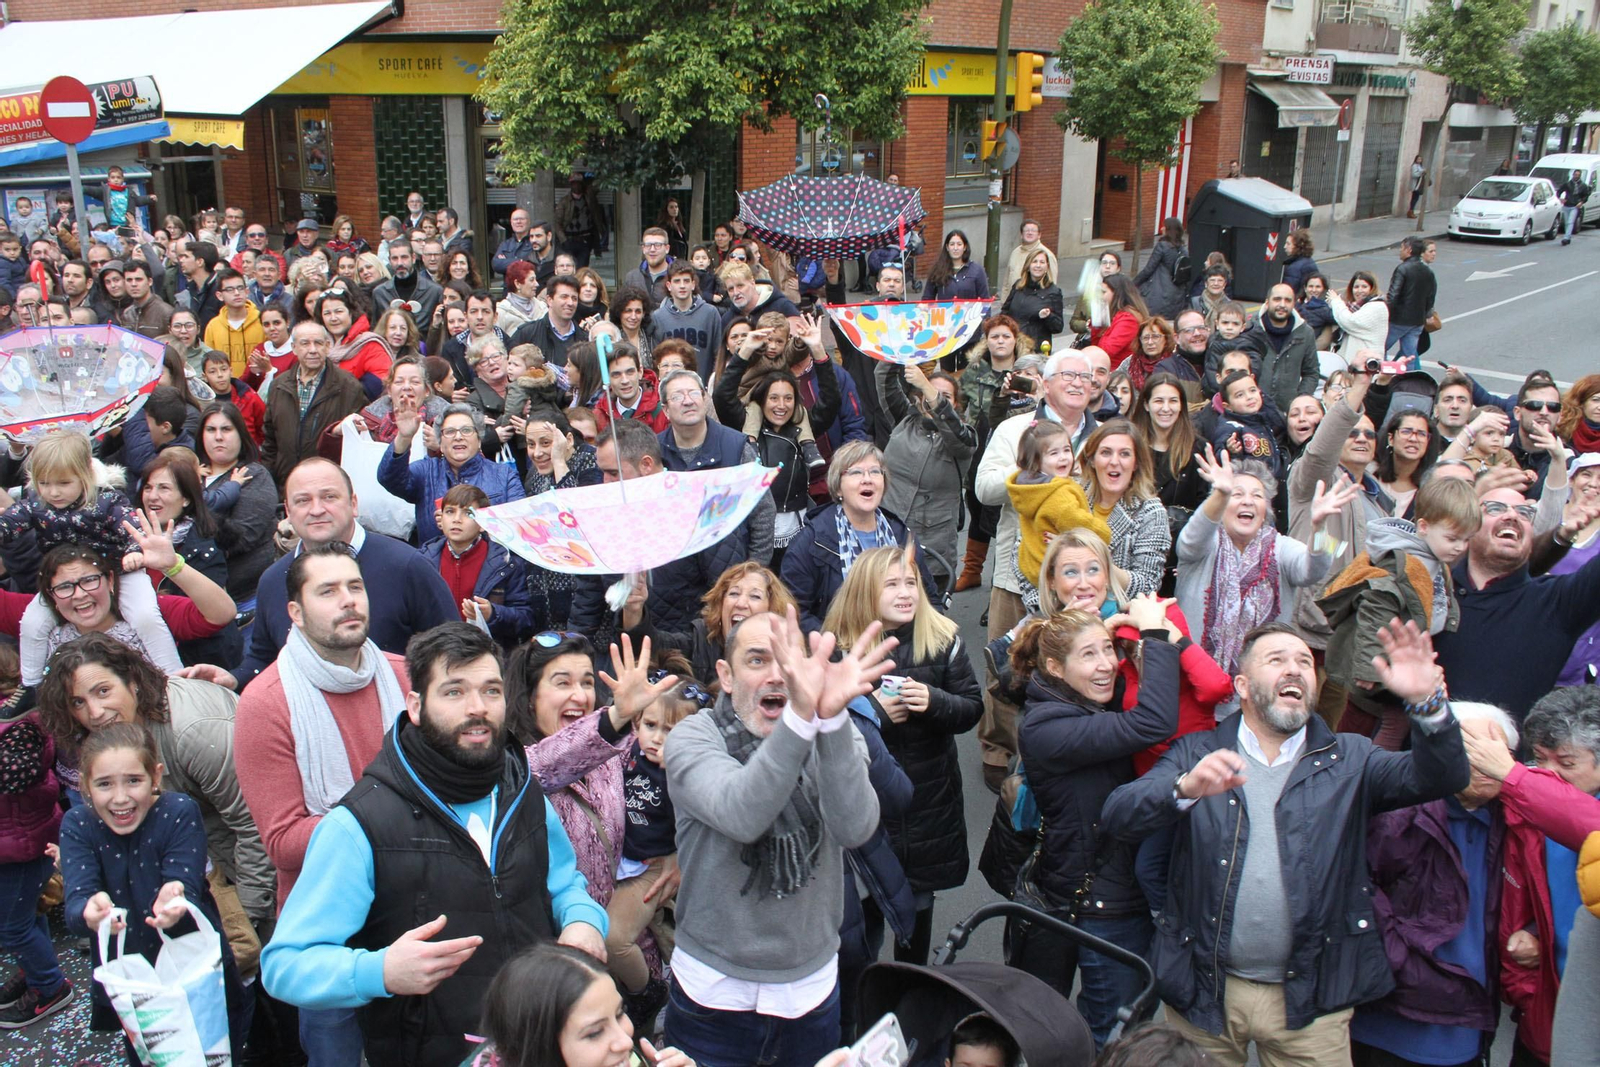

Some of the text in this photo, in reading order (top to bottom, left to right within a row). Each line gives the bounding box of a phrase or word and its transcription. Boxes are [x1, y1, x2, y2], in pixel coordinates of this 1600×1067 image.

[378, 55, 443, 71] SPORT CAFÉ
[1285, 58, 1329, 69] PRENSA
[1045, 74, 1071, 84] luckia
[0, 98, 20, 118] CO
[194, 121, 211, 133] SPORT
[18, 133, 24, 141] Y
[25, 130, 52, 140] HELA
